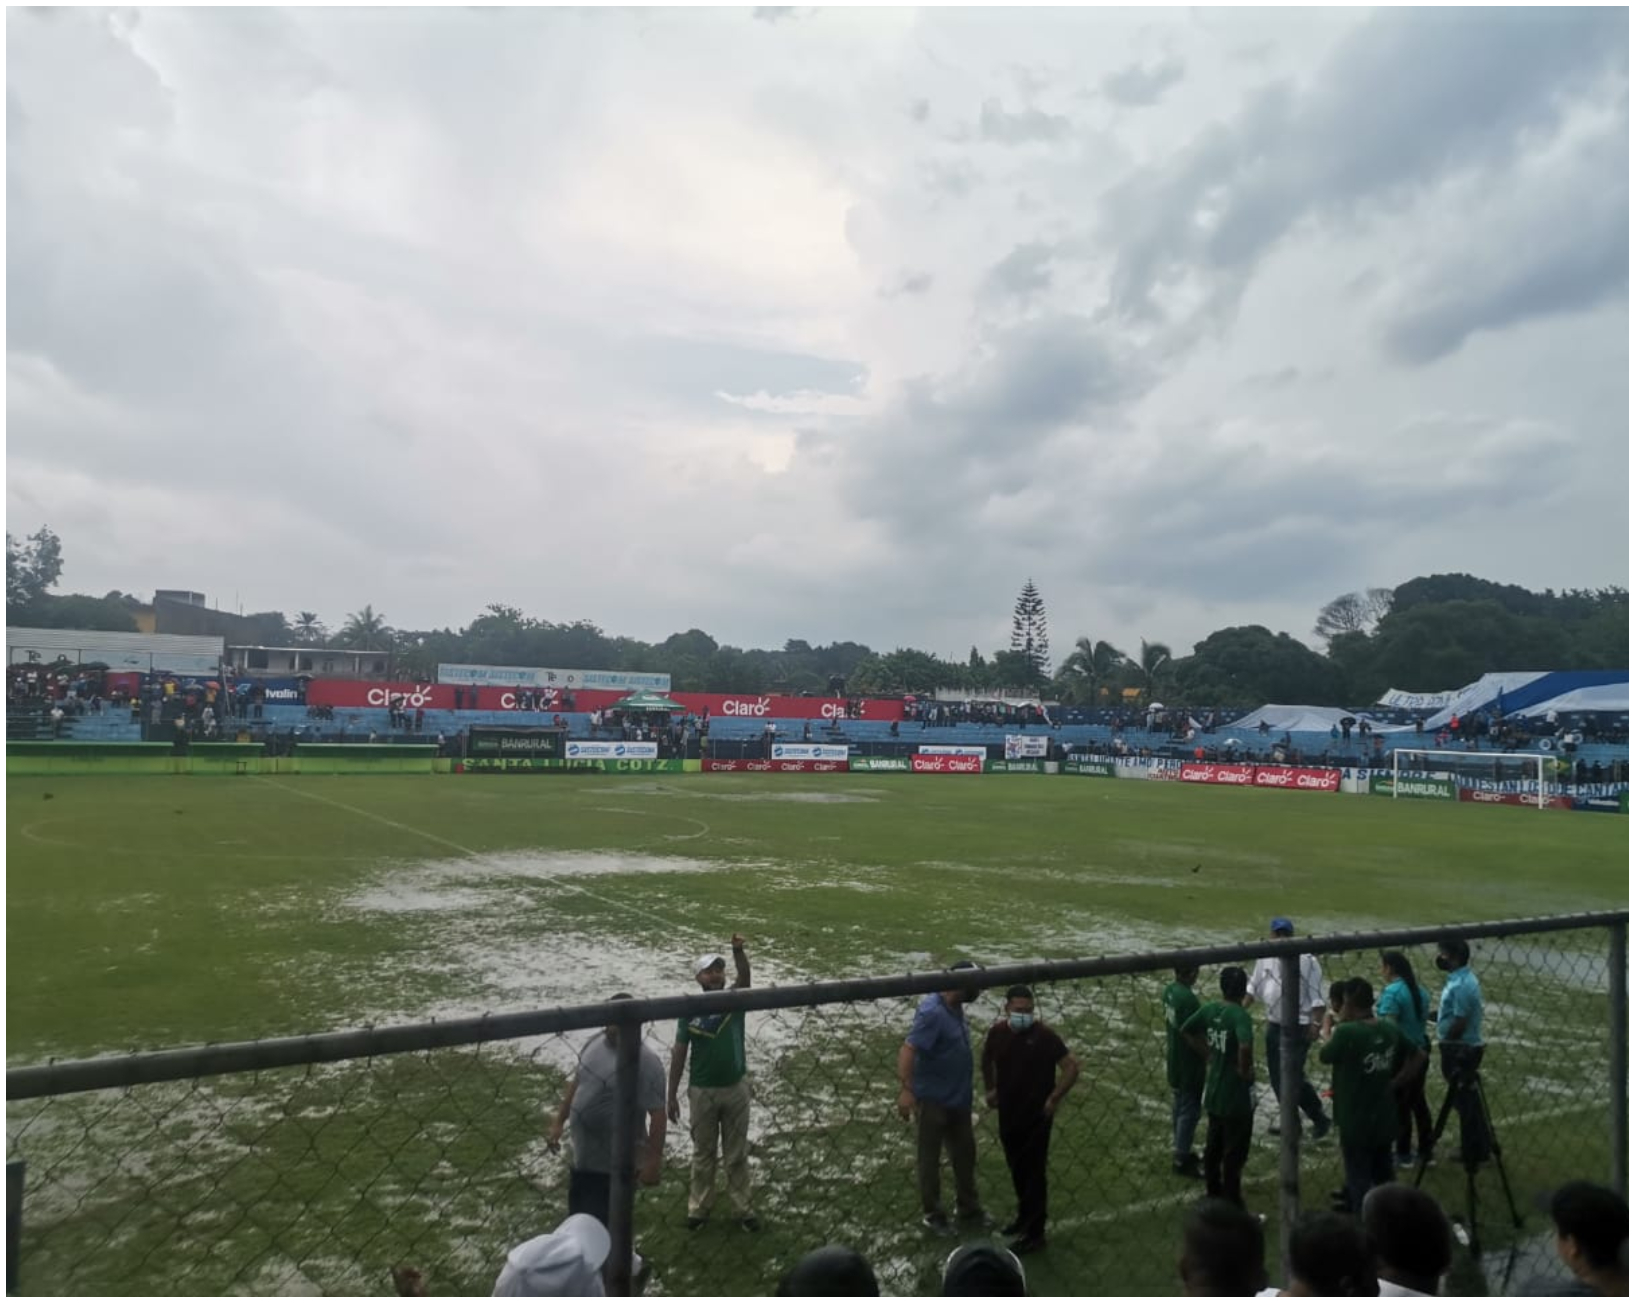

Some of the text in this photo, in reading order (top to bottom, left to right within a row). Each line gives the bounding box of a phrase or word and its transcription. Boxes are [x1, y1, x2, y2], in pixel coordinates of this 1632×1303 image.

[722, 698, 769, 716] Claro
[1183, 767, 1213, 781] Claro
[1217, 769, 1250, 782] Claro
[1257, 770, 1291, 784] Claro
[1297, 773, 1334, 787] Claro
[1398, 782, 1450, 797] BANRURAL
